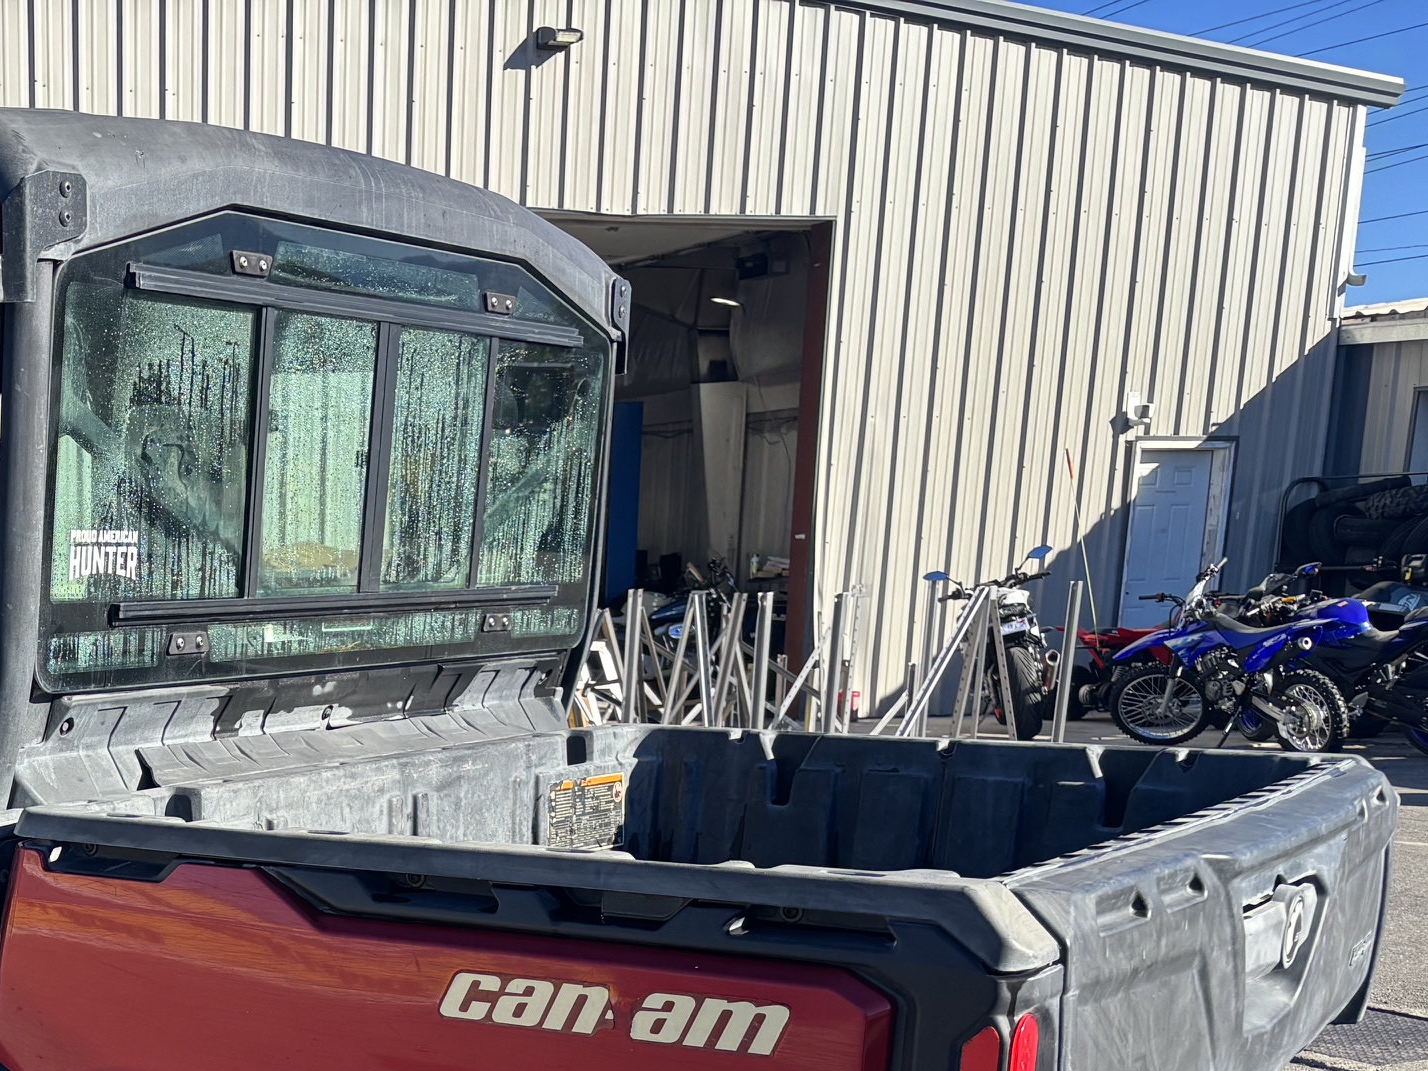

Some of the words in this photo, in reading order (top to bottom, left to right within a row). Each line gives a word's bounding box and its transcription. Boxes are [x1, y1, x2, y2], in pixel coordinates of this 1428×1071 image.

[71, 530, 97, 542] PROUD
[98, 530, 138, 543] AMERICAN
[69, 546, 138, 580] HUNTER
